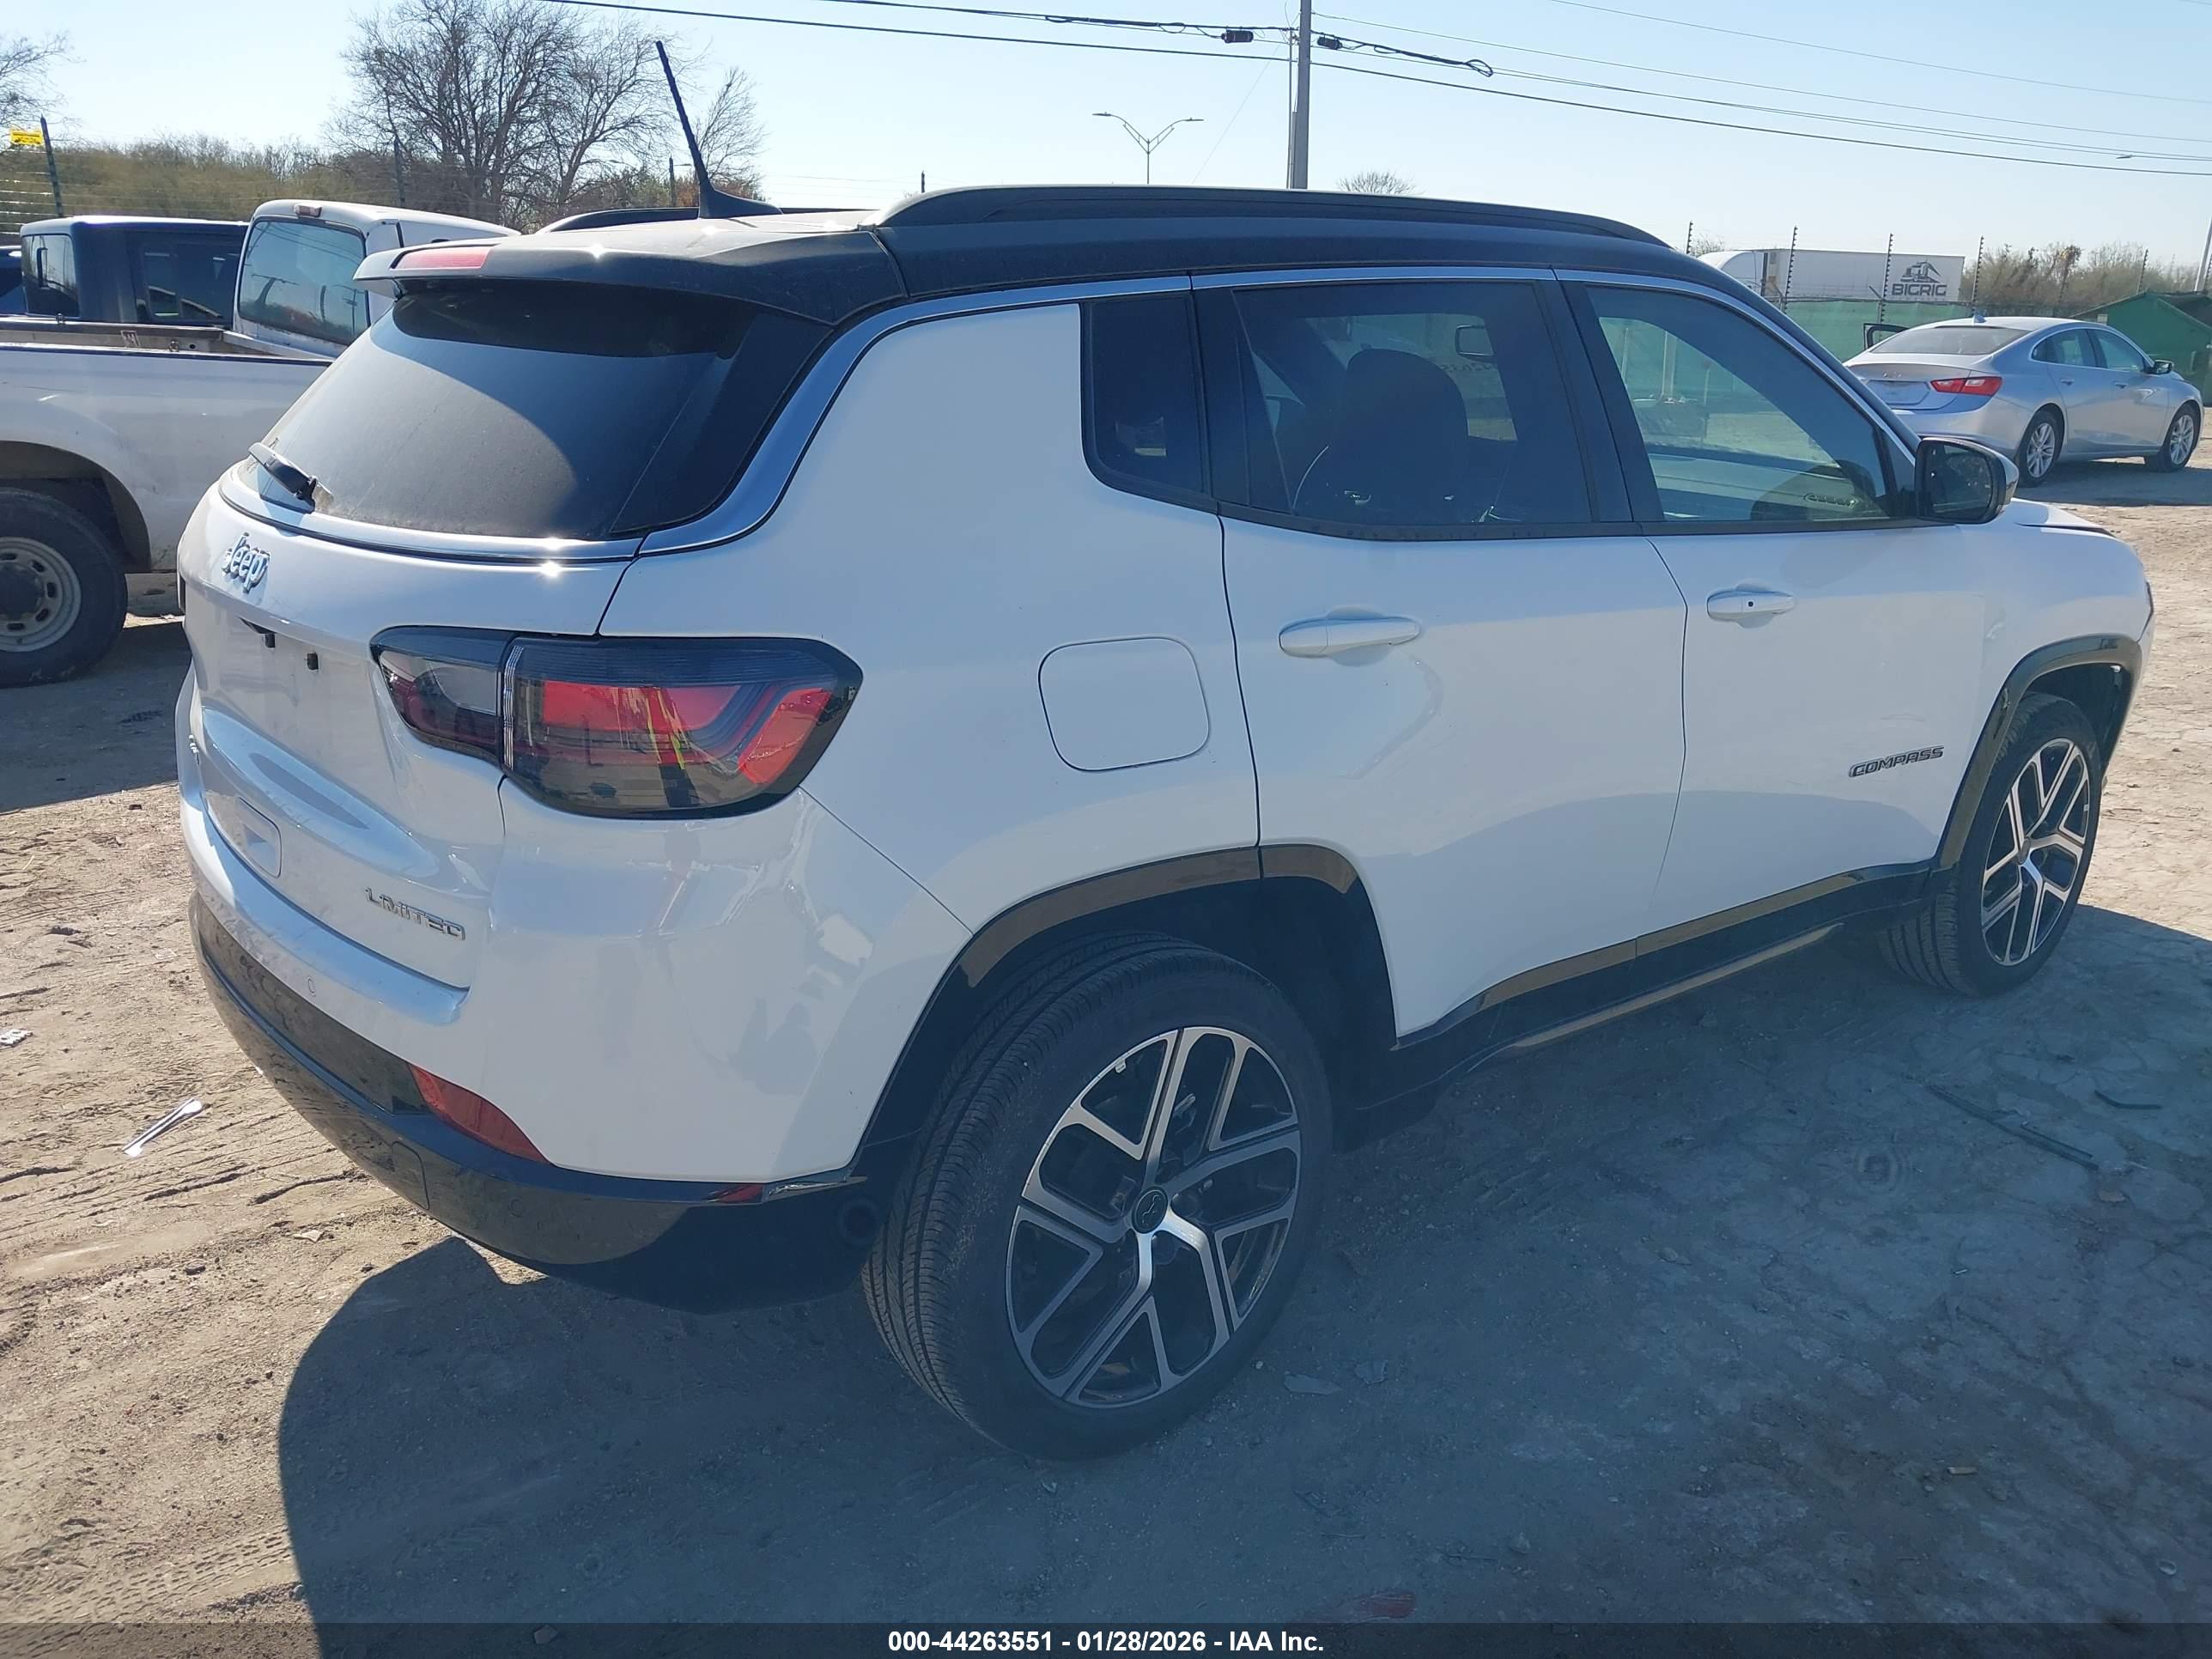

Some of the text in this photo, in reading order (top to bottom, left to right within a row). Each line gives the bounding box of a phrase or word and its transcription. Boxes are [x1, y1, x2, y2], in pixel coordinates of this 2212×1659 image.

[1891, 283, 1948, 296] BIGRIG
[222, 532, 270, 594] Jeep
[1849, 745, 1944, 777] COMPASS
[365, 887, 466, 941] LIMITED
